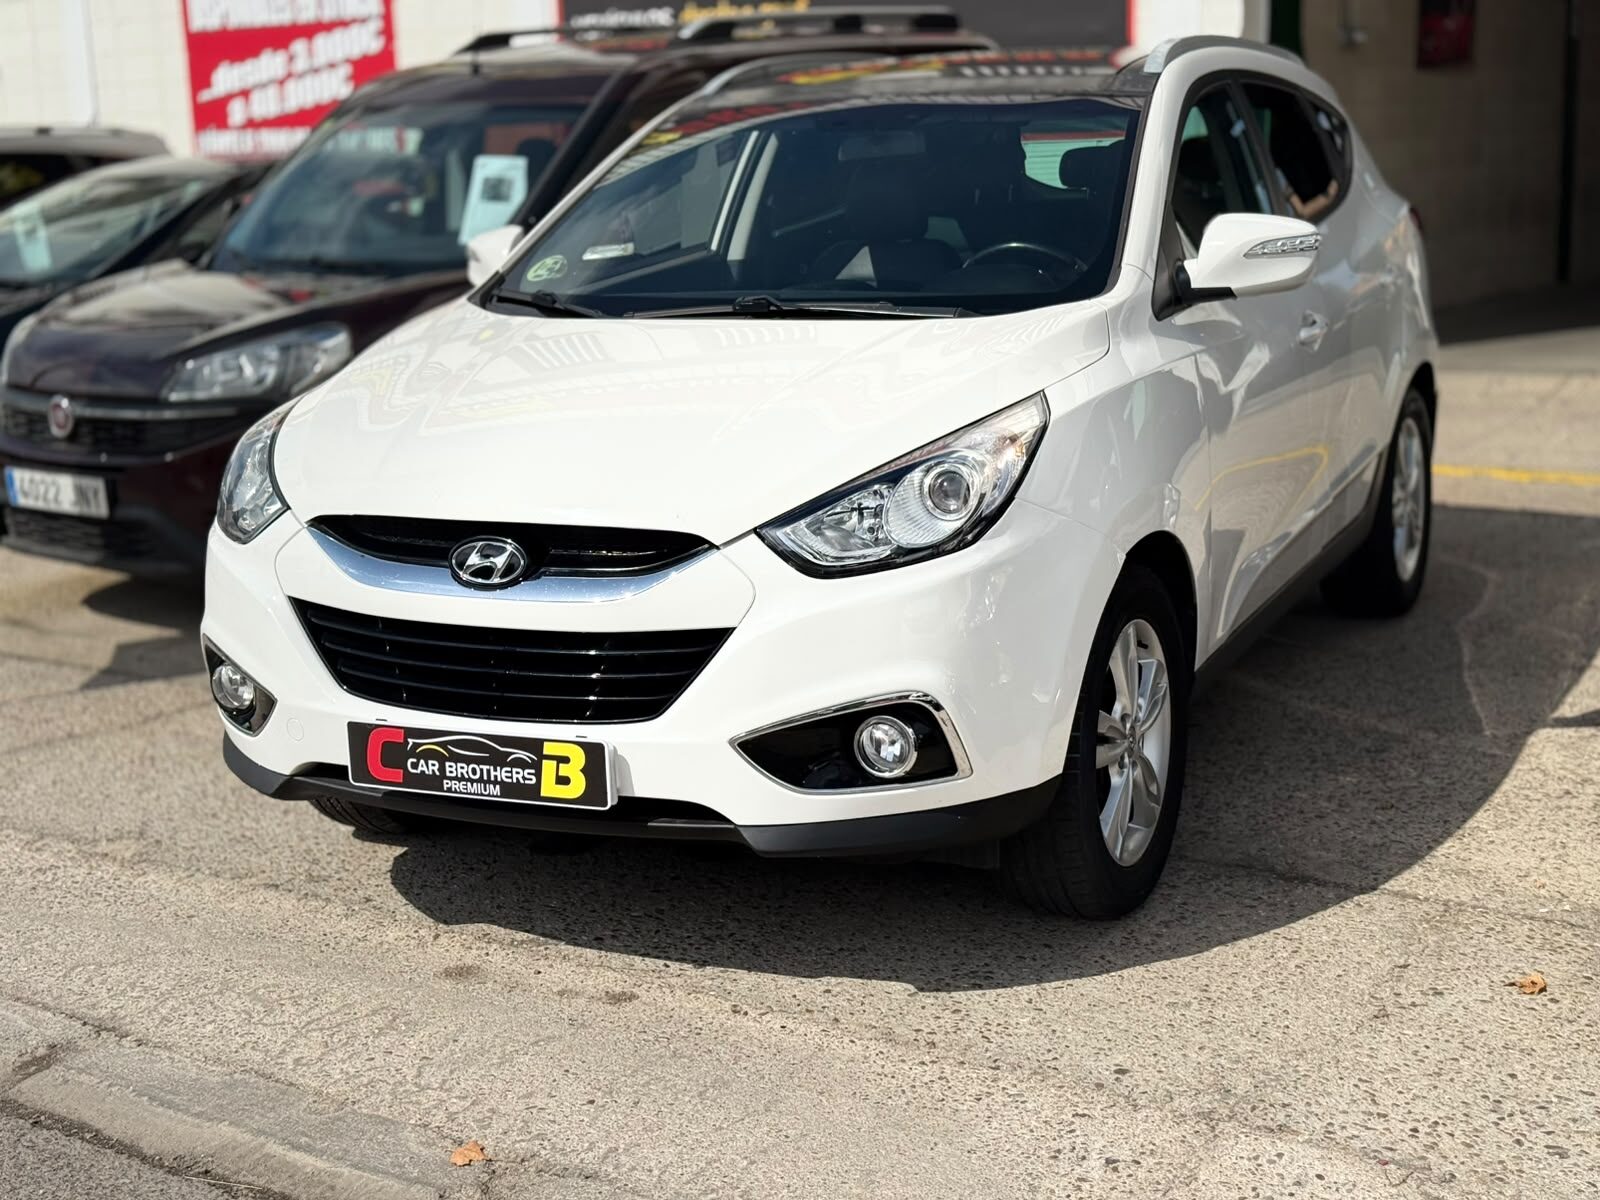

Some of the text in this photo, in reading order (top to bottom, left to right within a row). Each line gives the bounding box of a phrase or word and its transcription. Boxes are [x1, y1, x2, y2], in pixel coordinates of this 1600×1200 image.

[20, 475, 62, 505] 4022
[366, 727, 404, 783] C
[406, 757, 537, 785] CAR BROTHERS
[443, 779, 501, 796] PREMIUM
